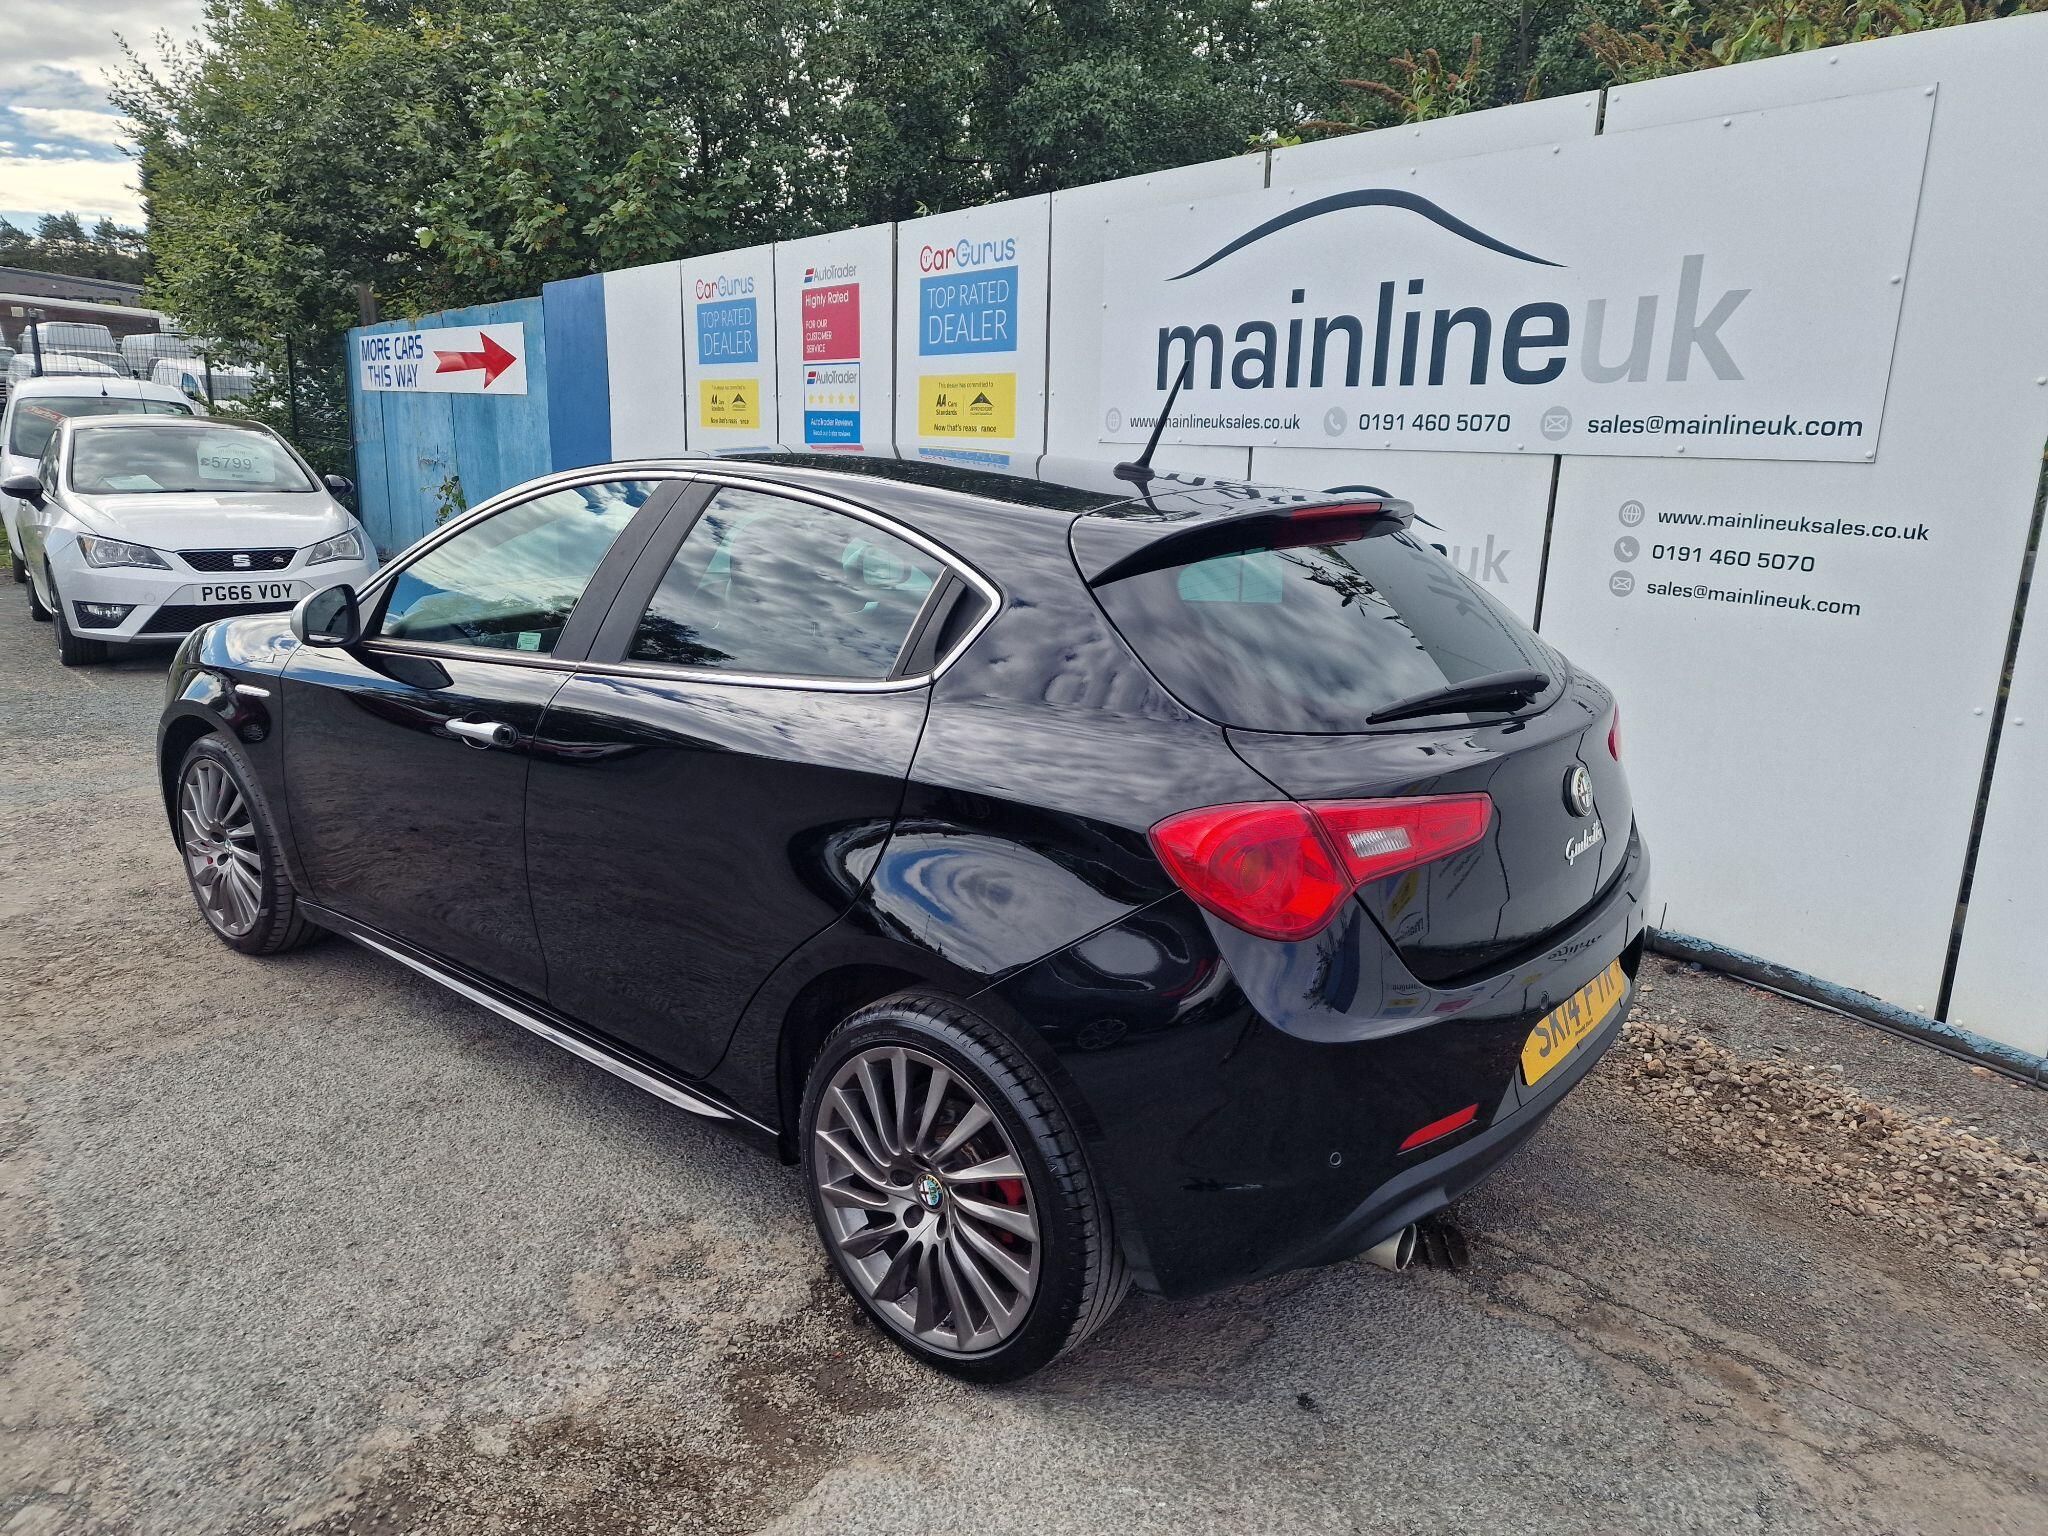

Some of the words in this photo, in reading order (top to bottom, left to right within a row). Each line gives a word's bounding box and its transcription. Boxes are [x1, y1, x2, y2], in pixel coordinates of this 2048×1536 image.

[920, 238, 1016, 272] CarGurus
[814, 263, 857, 281] AutoTrader
[696, 275, 755, 299] CarGurus
[805, 292, 826, 308] Highly
[827, 290, 849, 304] Rated
[928, 285, 956, 309] TOP
[960, 279, 1009, 306] RATED
[701, 311, 720, 328] TOP
[721, 307, 752, 327] RATED
[929, 309, 1008, 344] DEALER
[1156, 254, 1753, 391] mainlineuk
[361, 338, 391, 361] MORE
[394, 334, 424, 360] CARS
[703, 330, 753, 355] DEALER
[368, 364, 392, 388] THIS
[394, 363, 418, 388] WAY
[816, 371, 857, 384] AutoTrader
[934, 423, 946, 431] Now
[1130, 414, 1301, 430] wwwmainlineuksales.co.uk
[1358, 414, 1405, 431] 0191
[1411, 414, 1450, 431] 460
[1455, 415, 1511, 433] 5070
[1587, 414, 1864, 437] sales@mainlineuk.com
[1658, 511, 1930, 541] www.mainlineuksales.co.uk
[1652, 544, 1702, 563] 0191
[1709, 549, 1751, 567] 460
[1757, 552, 1816, 572] 5070
[201, 585, 252, 601] PG66
[258, 583, 293, 599] VOY
[1647, 581, 1861, 616] sales@mainlineuk.com
